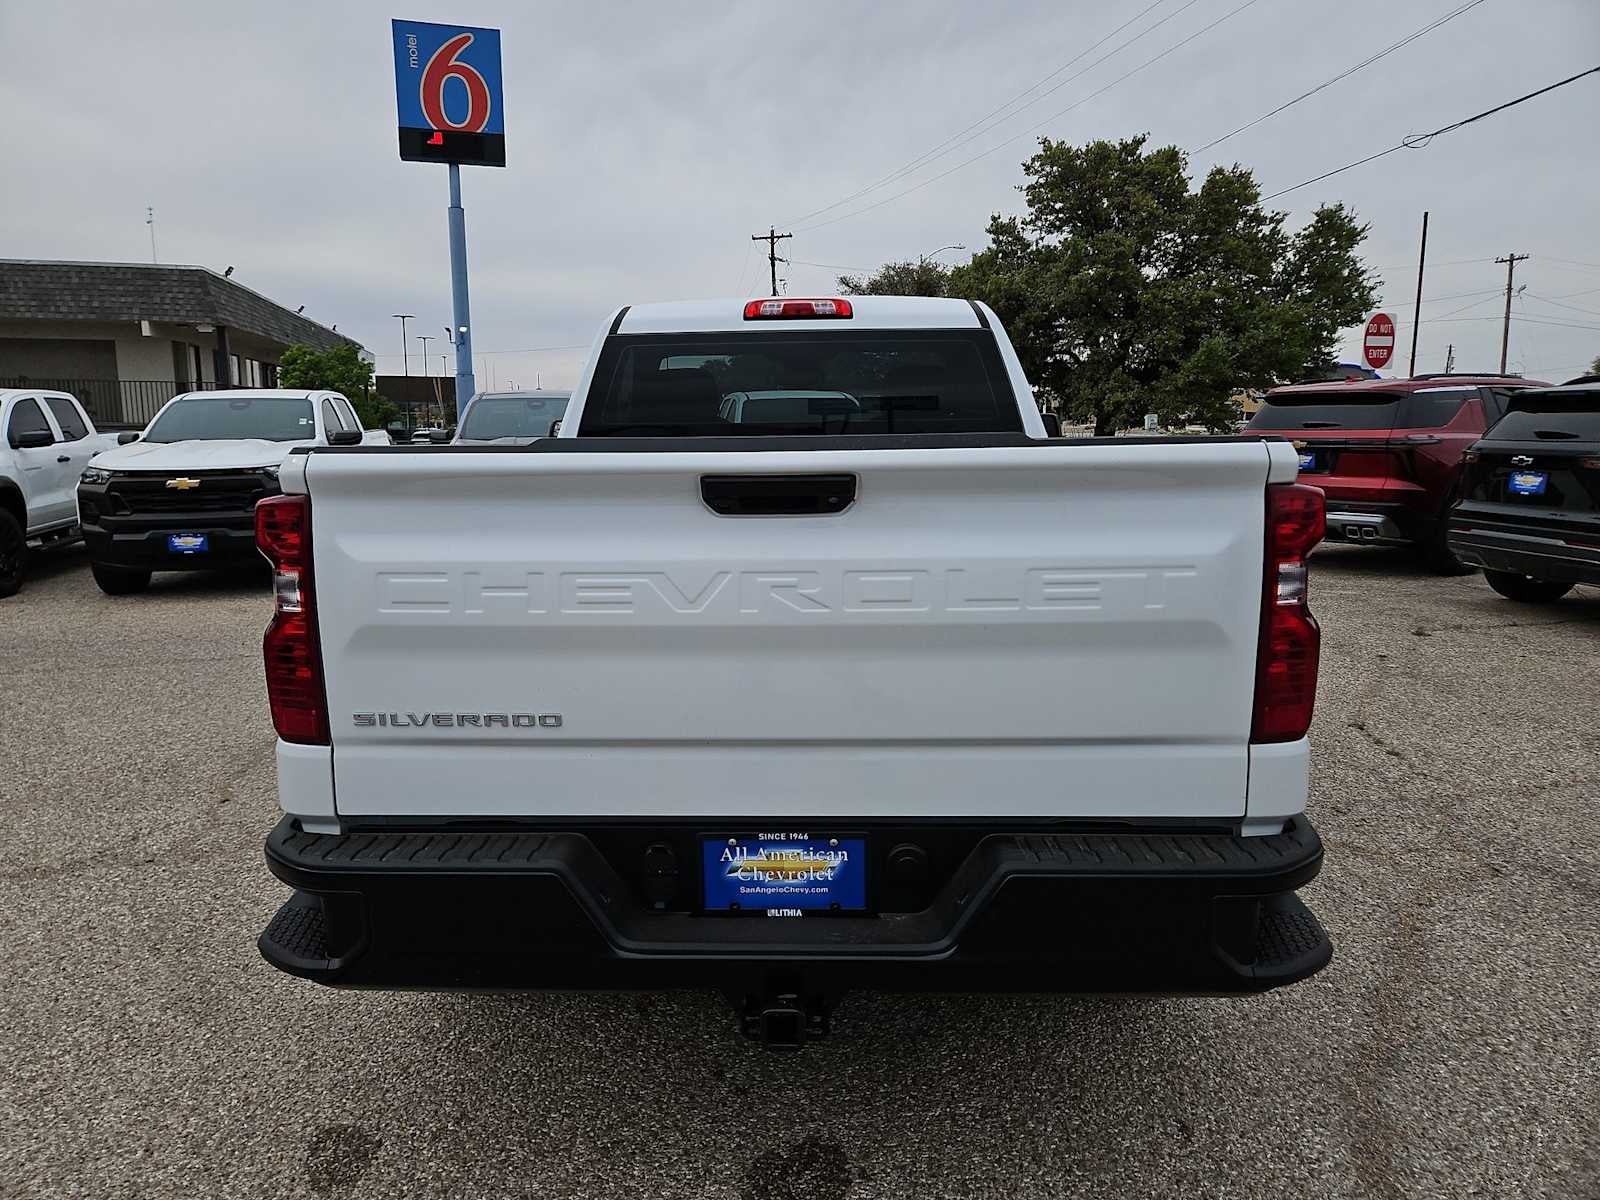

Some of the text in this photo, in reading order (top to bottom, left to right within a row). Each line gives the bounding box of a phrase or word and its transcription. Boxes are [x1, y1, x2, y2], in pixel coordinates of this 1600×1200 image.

[406, 33, 418, 68] motel
[419, 32, 491, 132] 6
[1369, 324, 1392, 333] DO NOT
[1368, 349, 1388, 358] ENTER
[376, 565, 1198, 614] CHEVROLET
[352, 712, 563, 728] SILVERADO
[719, 846, 849, 862] All American
[737, 865, 834, 882] Chevrolet
[739, 886, 829, 894] SanAngeloChevy.com
[775, 908, 802, 916] LITHIA
